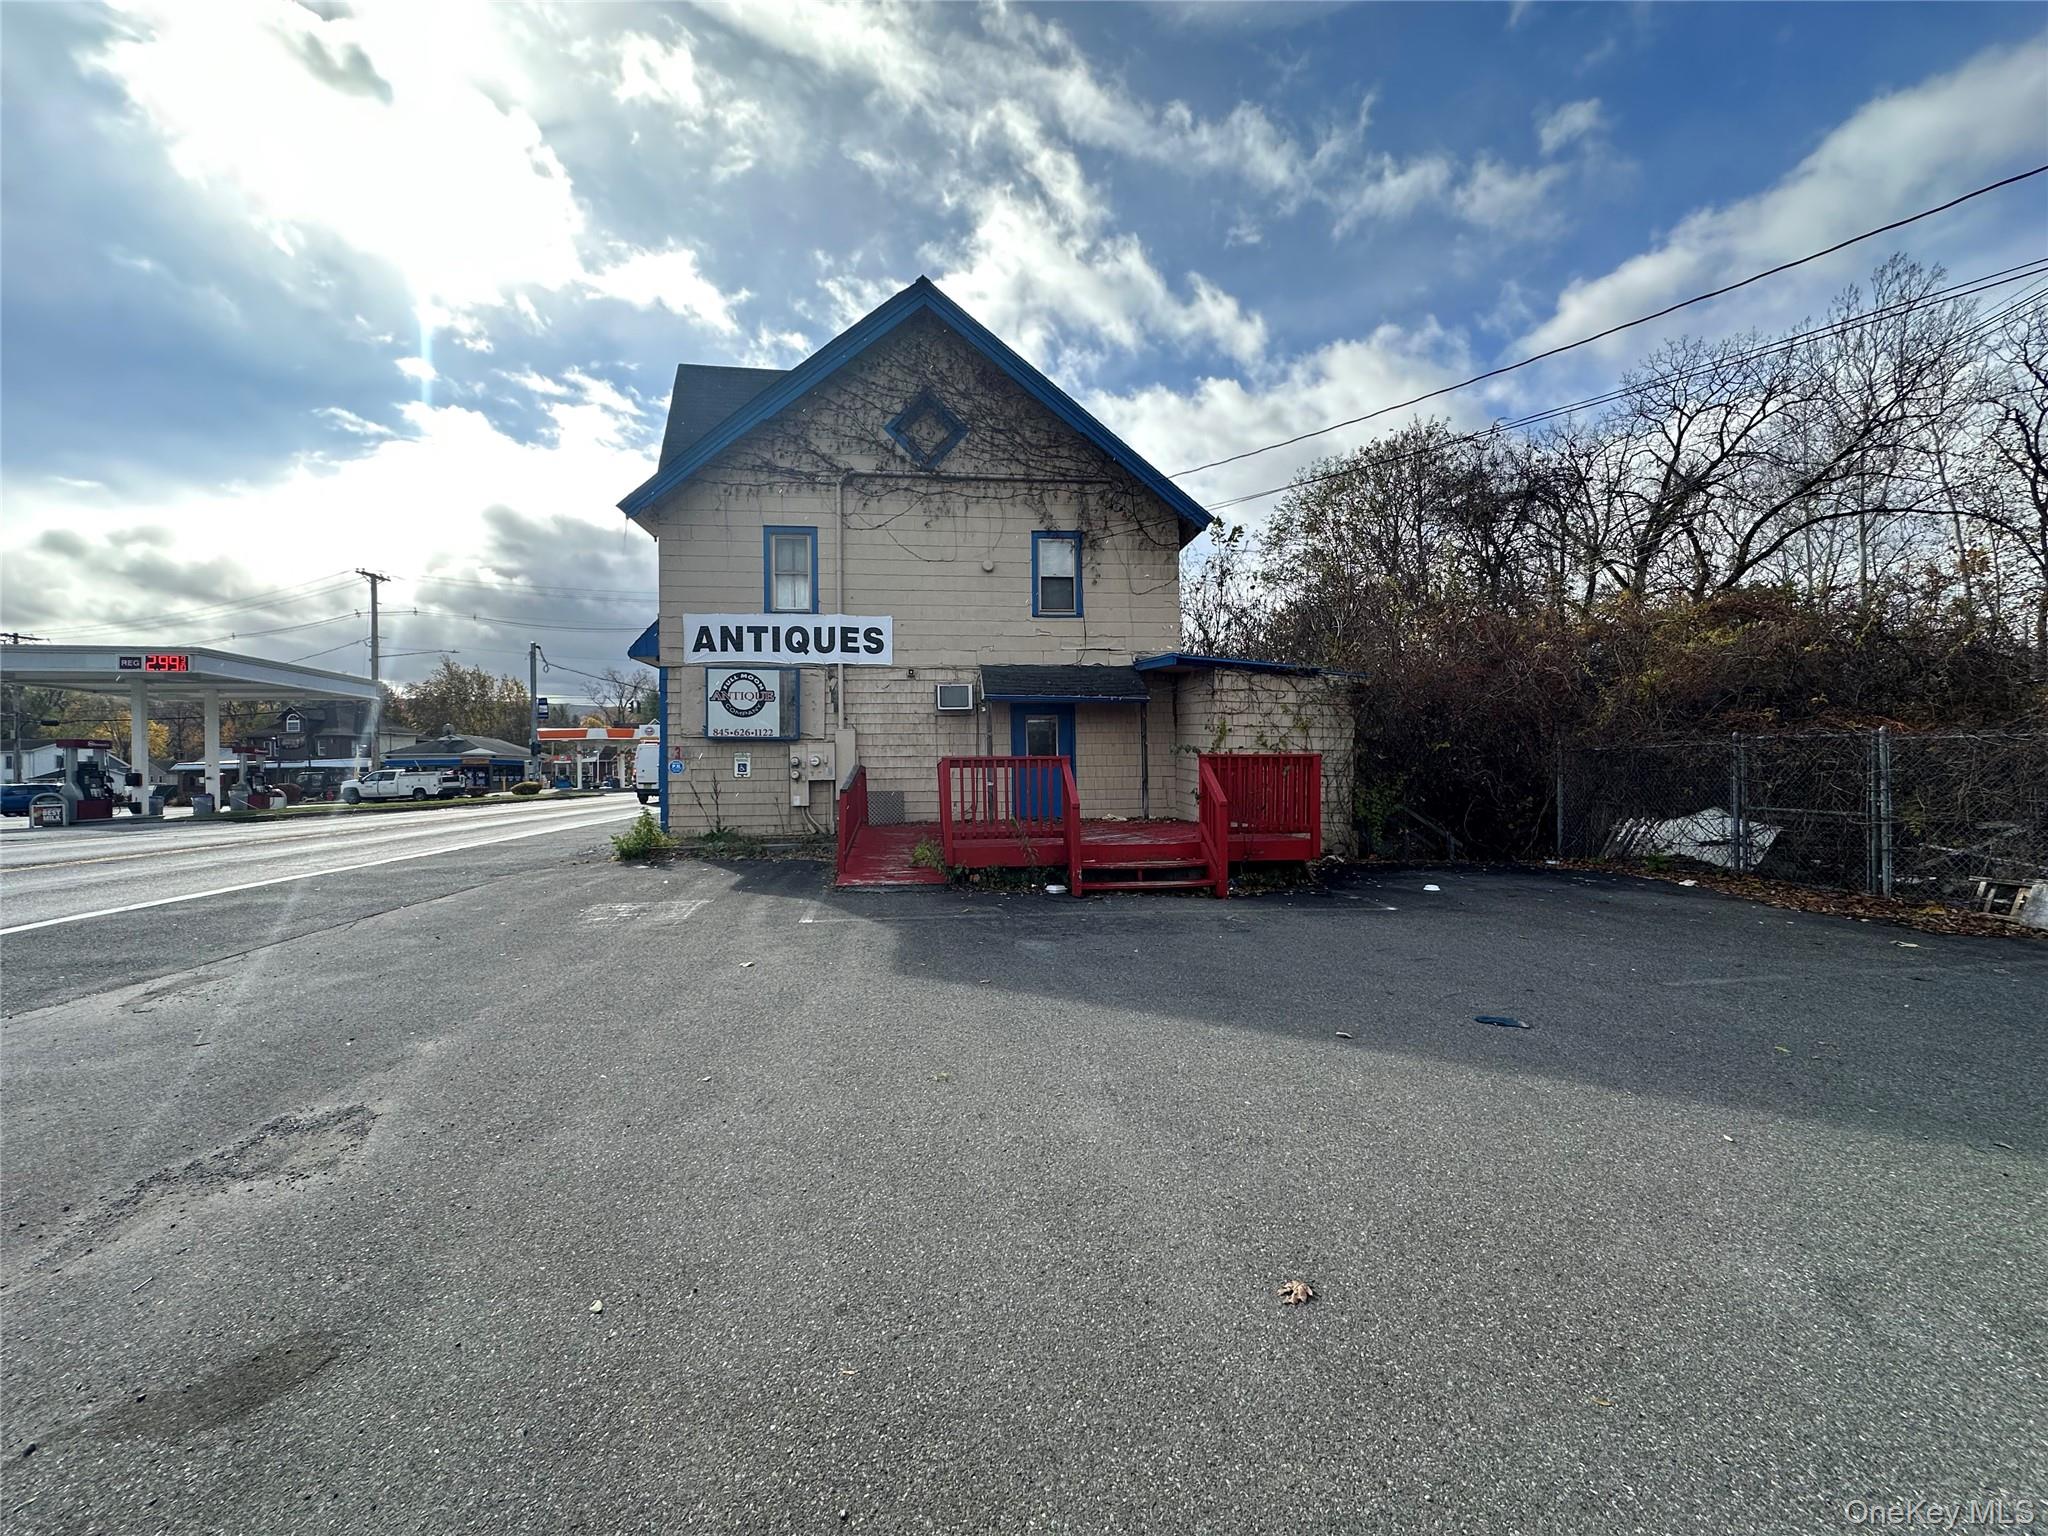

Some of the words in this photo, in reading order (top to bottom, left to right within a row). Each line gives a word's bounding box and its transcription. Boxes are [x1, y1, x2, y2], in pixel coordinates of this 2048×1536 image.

[692, 625, 885, 656] ANTIQUES
[121, 659, 139, 667] REG
[723, 675, 739, 690] FULL
[740, 673, 765, 690] MOON
[710, 689, 776, 702] ANTIQUE
[725, 702, 762, 716] COMPANY
